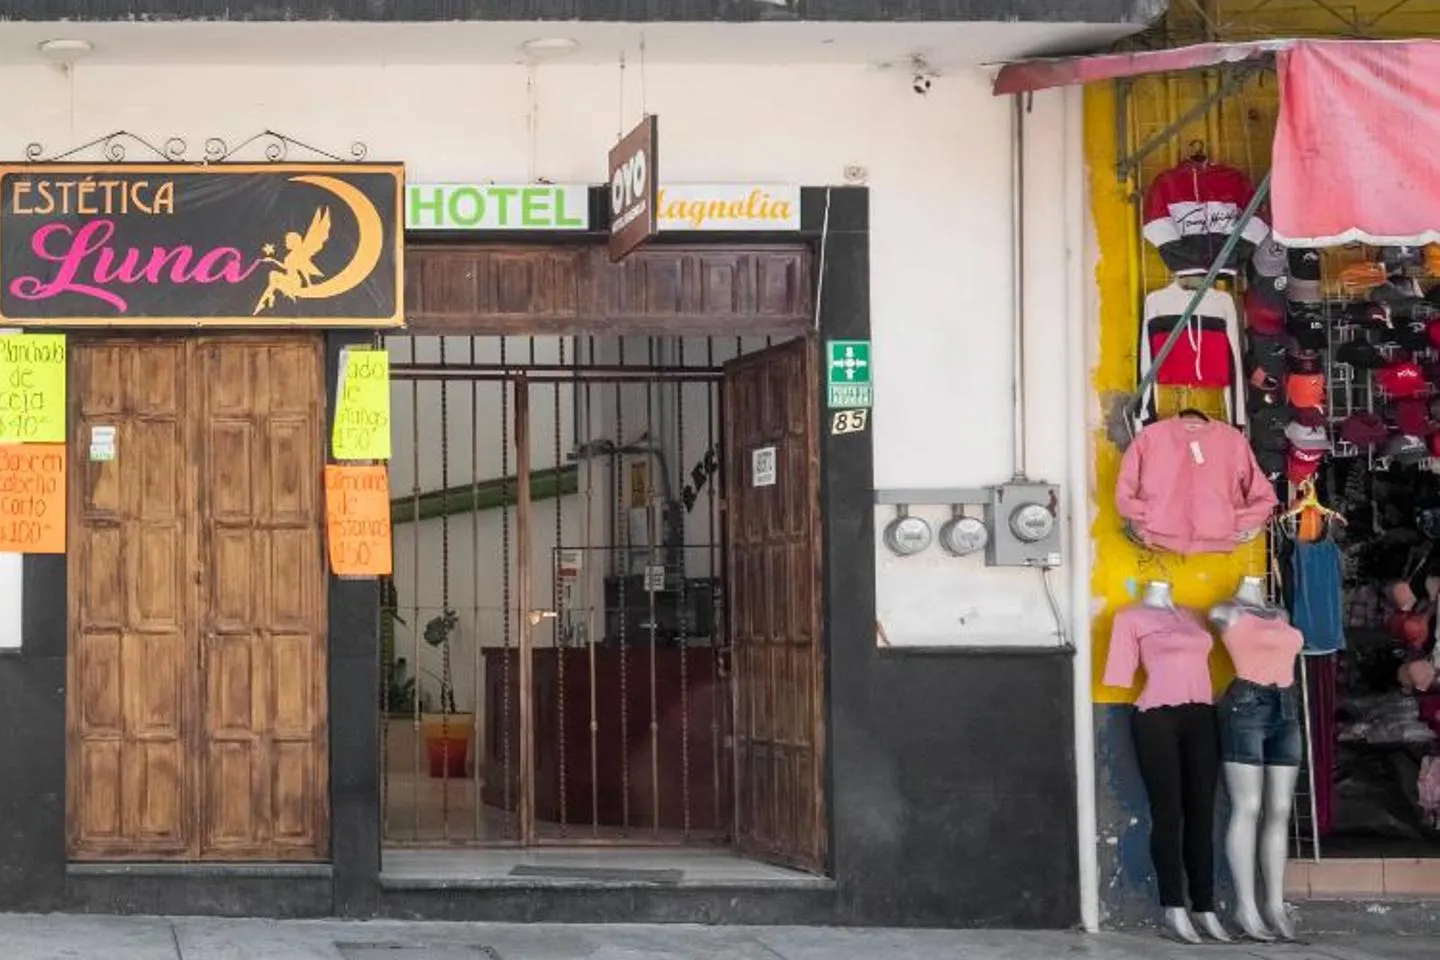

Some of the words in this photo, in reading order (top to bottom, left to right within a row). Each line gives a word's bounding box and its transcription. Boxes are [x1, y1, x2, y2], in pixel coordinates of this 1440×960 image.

[12, 176, 175, 215] ESTÉTICA
[612, 149, 646, 215] OYO
[410, 187, 583, 227] HOTEL
[657, 188, 791, 228] agnolia
[9, 219, 259, 313] Luna
[835, 410, 865, 431] 85
